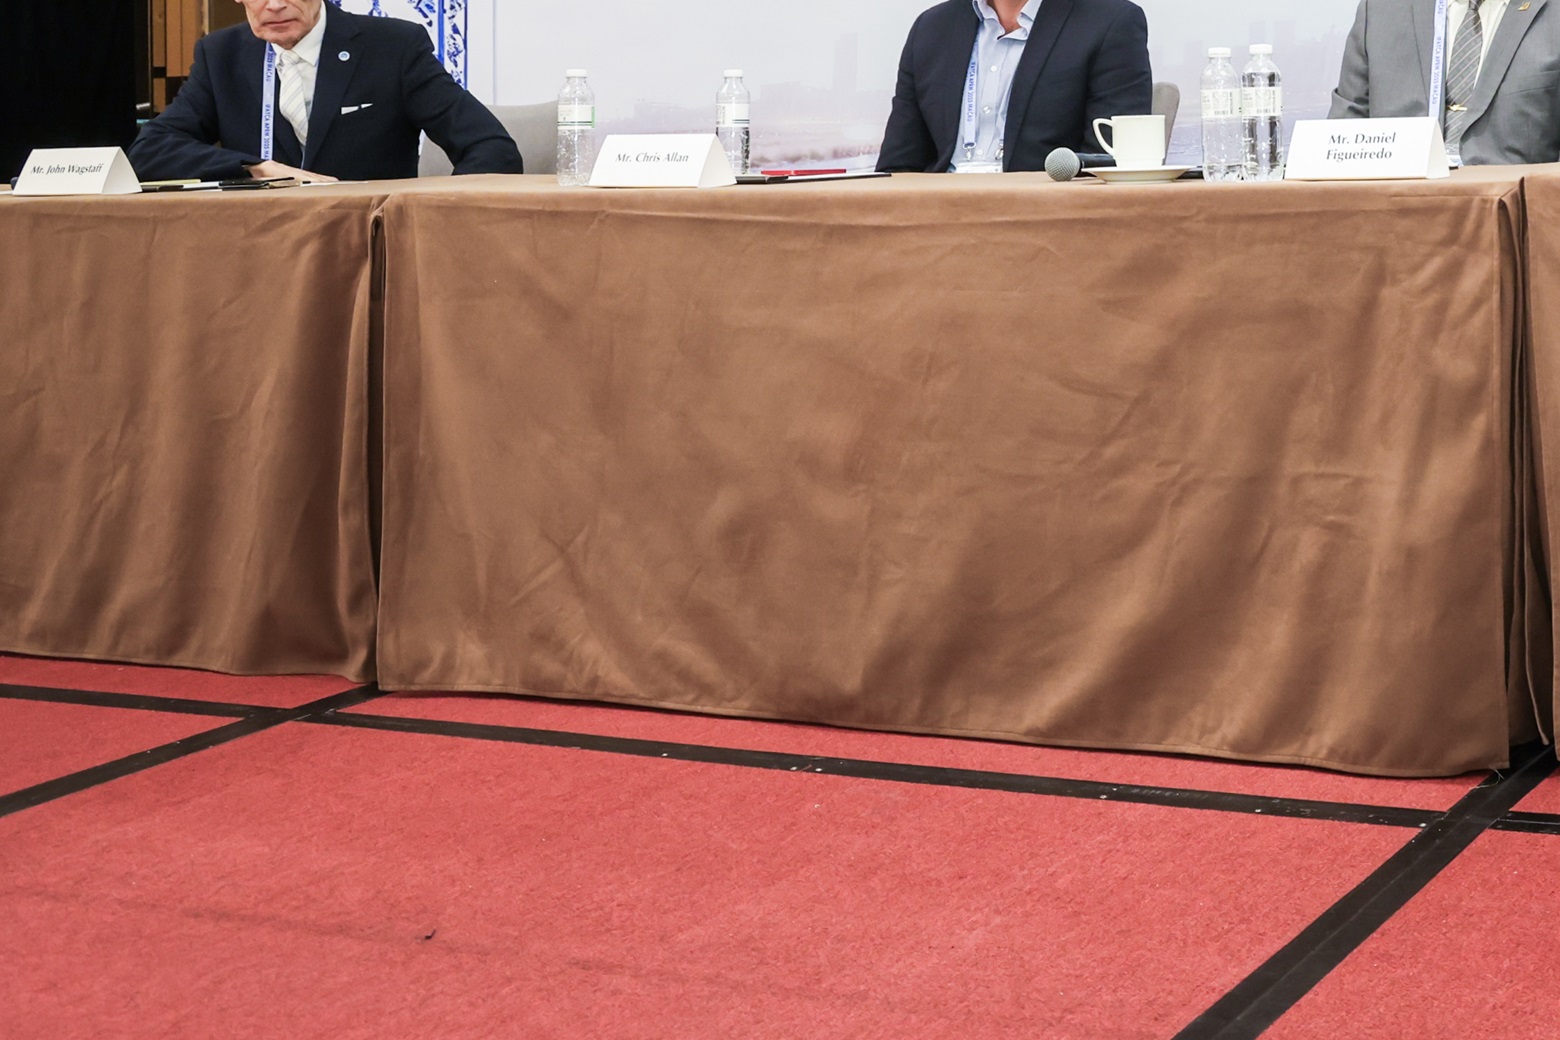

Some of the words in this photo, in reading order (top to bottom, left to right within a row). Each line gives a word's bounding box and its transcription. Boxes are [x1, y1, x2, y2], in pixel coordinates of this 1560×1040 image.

[1328, 134, 1350, 145] Mr.
[1354, 132, 1396, 144] Daniel
[615, 153, 632, 163] Mr.
[635, 152, 661, 163] Chris
[663, 152, 689, 162] Allan
[1326, 147, 1393, 163] Figueiredo
[30, 165, 45, 175] Mr.
[46, 164, 66, 175] John
[67, 163, 104, 176] Wagstaff
